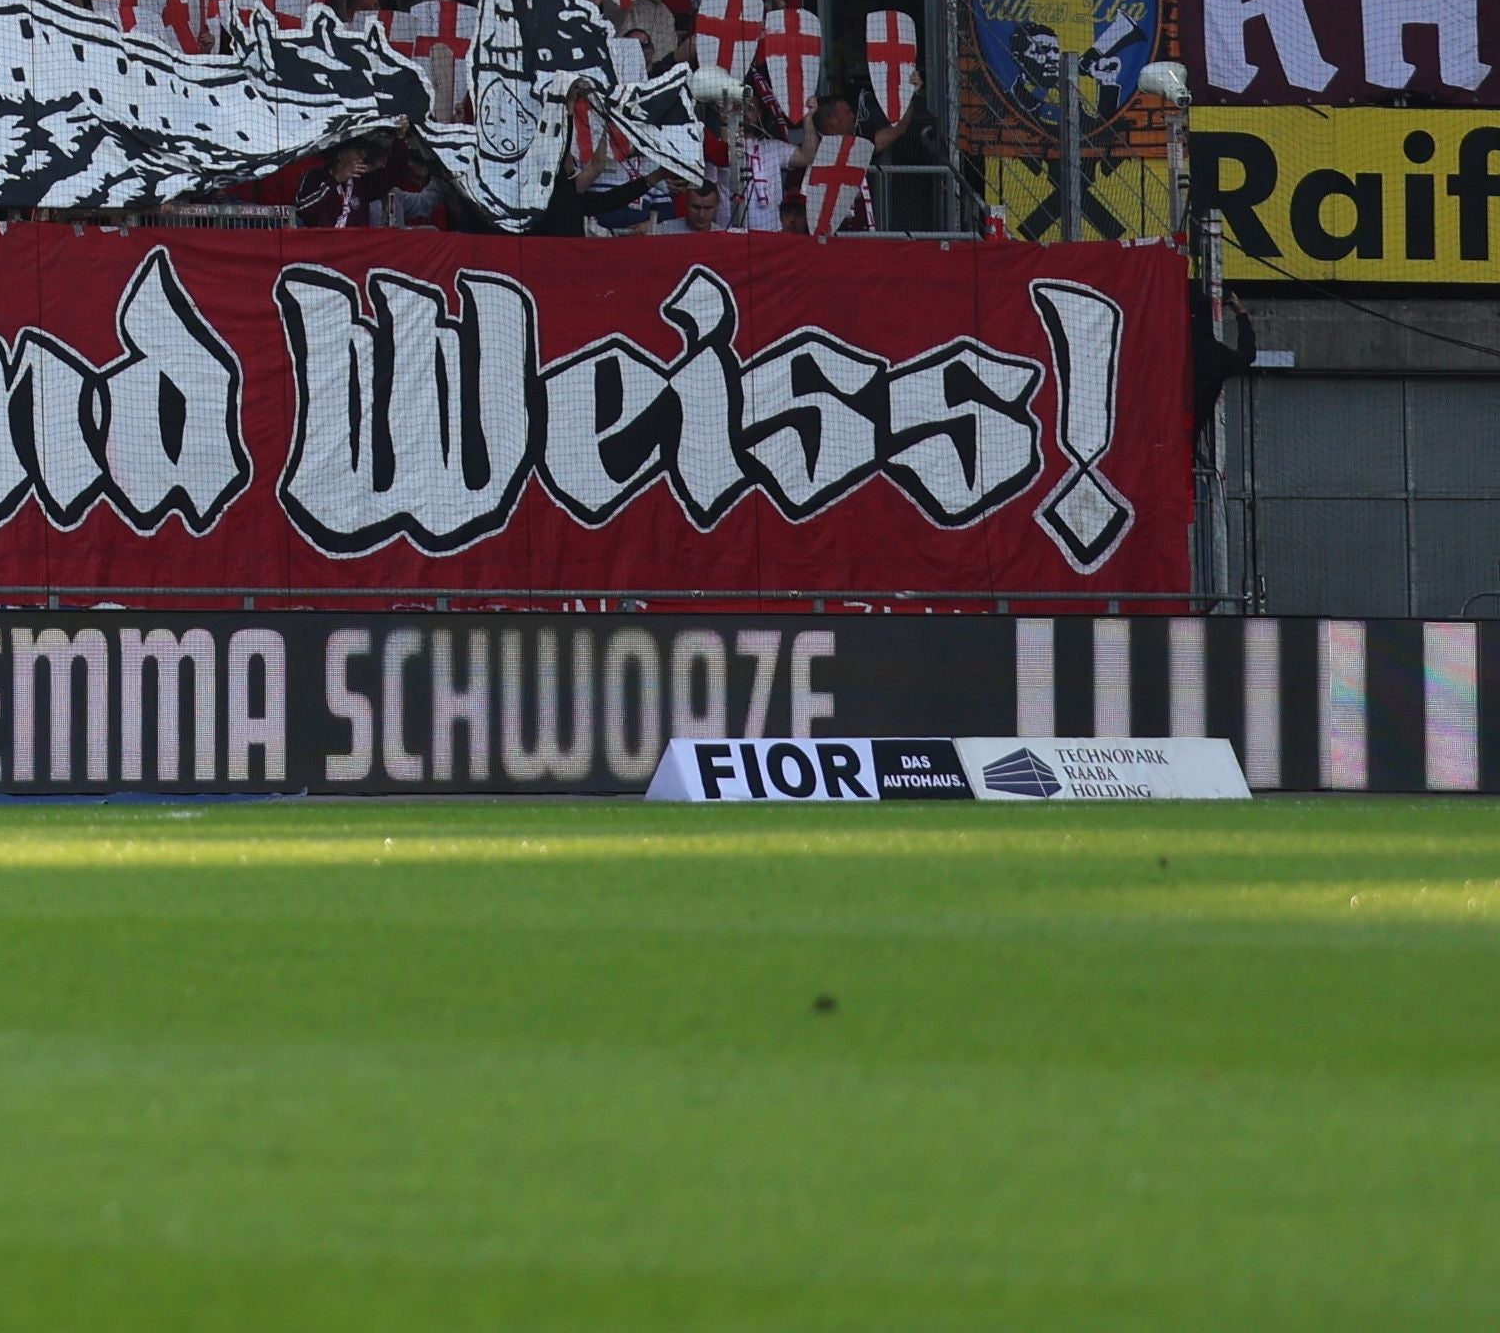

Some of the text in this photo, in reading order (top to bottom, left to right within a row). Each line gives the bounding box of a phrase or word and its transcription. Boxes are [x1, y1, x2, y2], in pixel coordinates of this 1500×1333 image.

[274, 261, 1136, 574] Weiss!
[900, 755, 931, 769] DAS
[1054, 748, 1169, 765] TECHNOPARK
[694, 742, 873, 800] FIOR
[1063, 766, 1118, 781] RAABA
[883, 773, 965, 788] AUTOHAUS.
[1072, 783, 1151, 798] HOLDING
